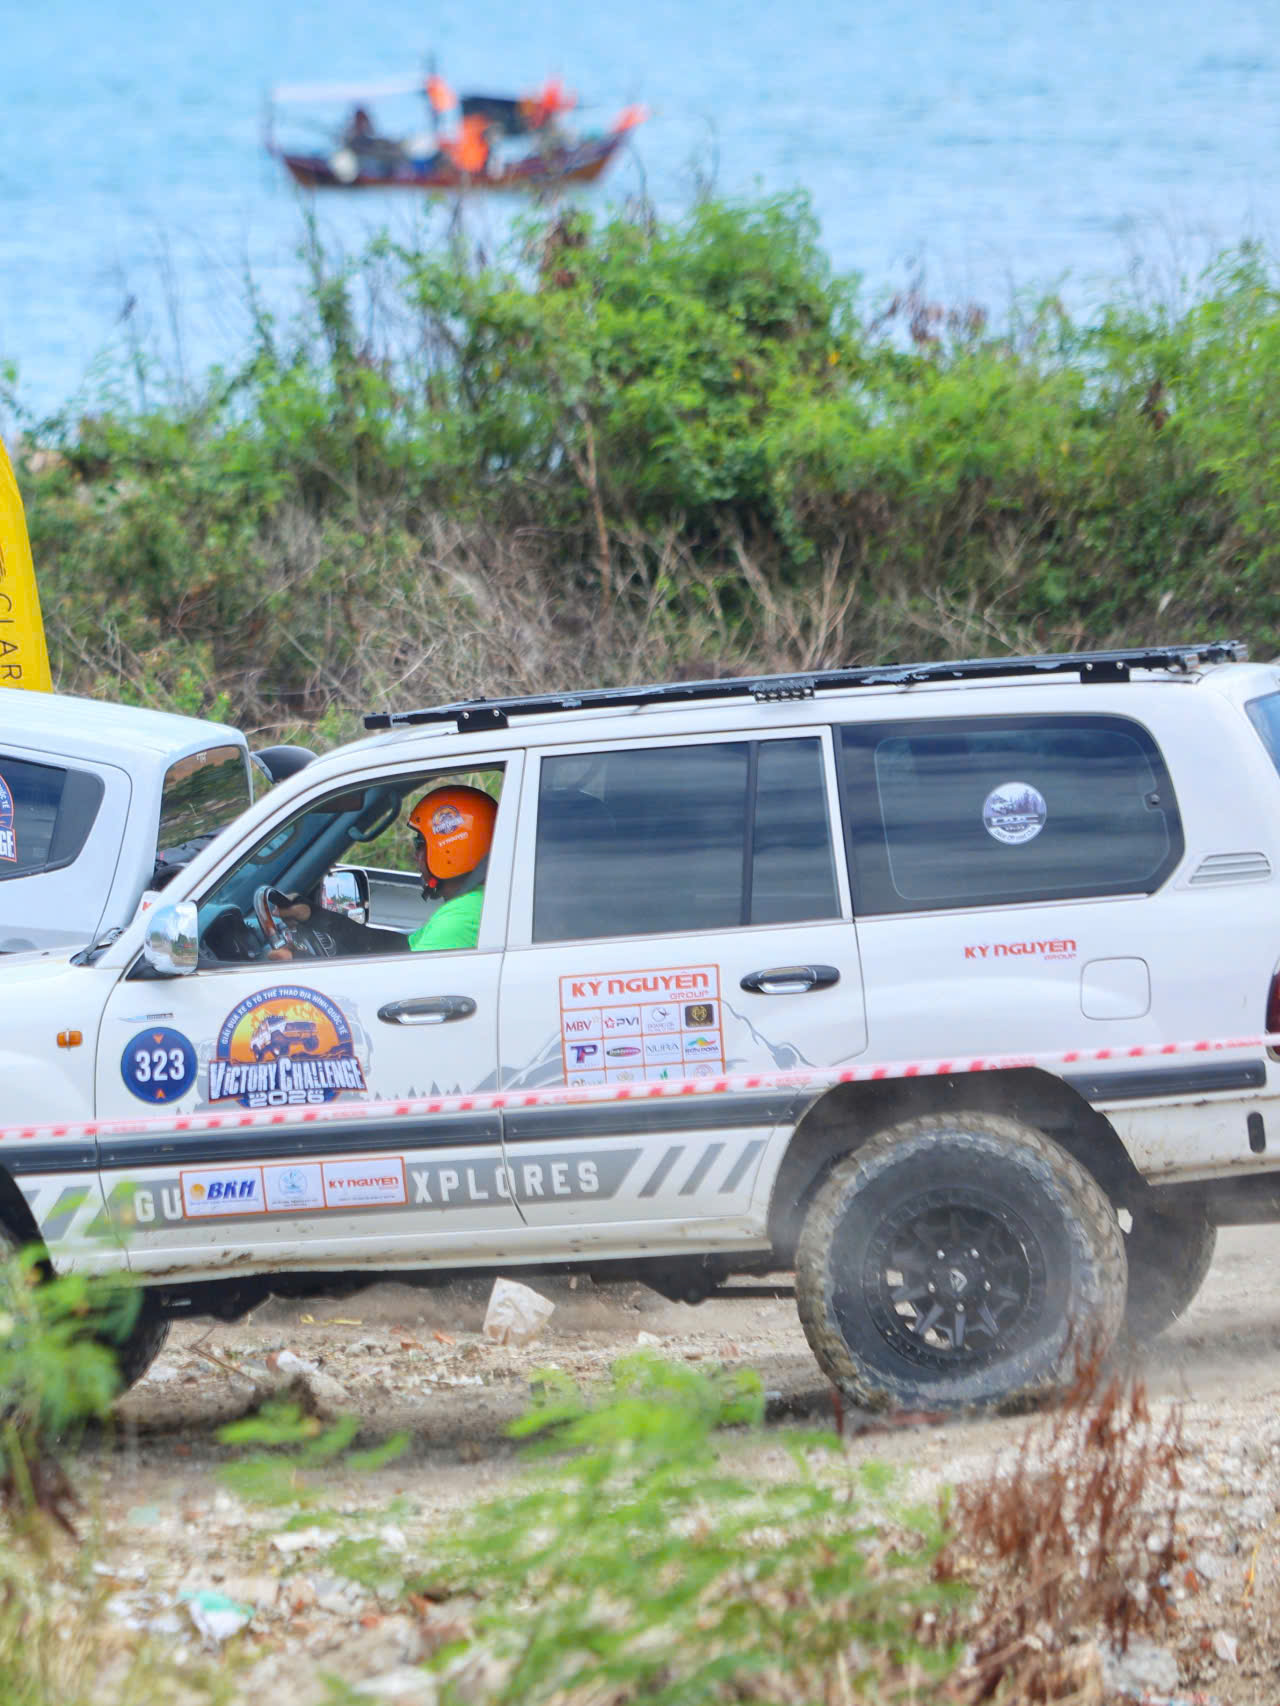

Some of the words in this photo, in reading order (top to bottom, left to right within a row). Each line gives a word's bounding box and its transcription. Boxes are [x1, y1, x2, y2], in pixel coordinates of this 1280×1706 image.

[670, 990, 709, 1000] GROUP
[566, 1020, 592, 1033] MBV
[617, 1017, 640, 1028] PVI
[135, 1049, 185, 1082] 323
[209, 1061, 278, 1100] VICTORY
[278, 1057, 366, 1090] CHALLENGE
[207, 1180, 256, 1200] BKH
